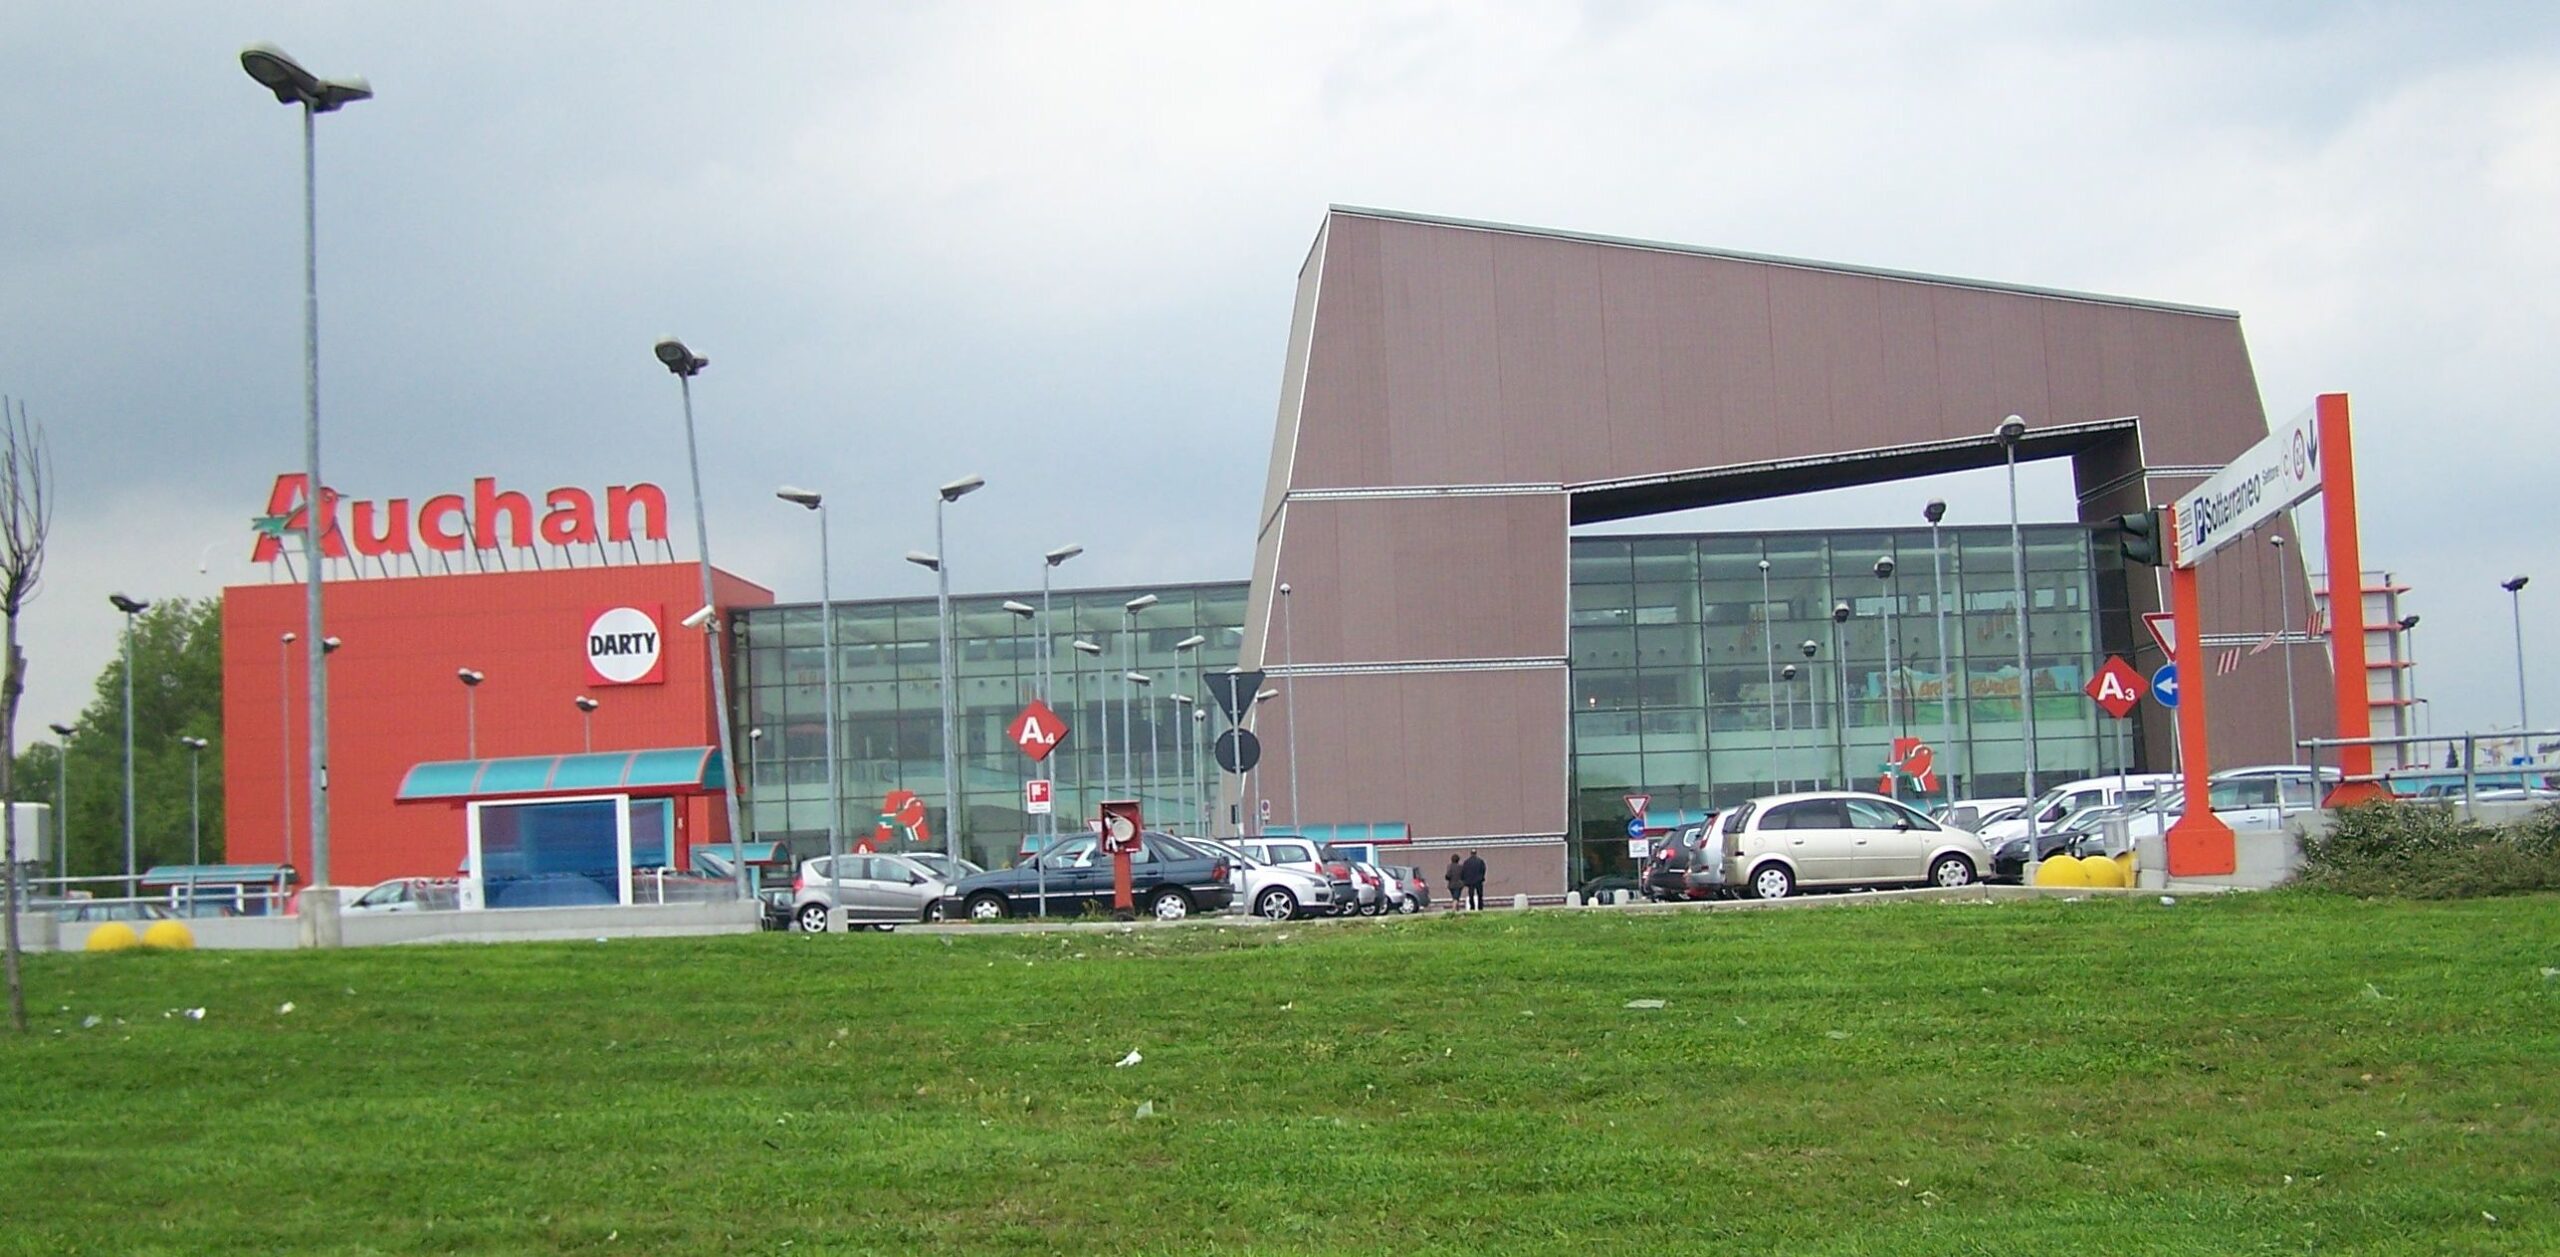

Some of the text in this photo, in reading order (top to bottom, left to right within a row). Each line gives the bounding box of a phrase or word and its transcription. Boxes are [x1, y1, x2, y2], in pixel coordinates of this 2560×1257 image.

[252, 473, 668, 562] Auchan
[2205, 474, 2260, 534] Sotterraneo
[590, 632, 656, 656] DARTY
